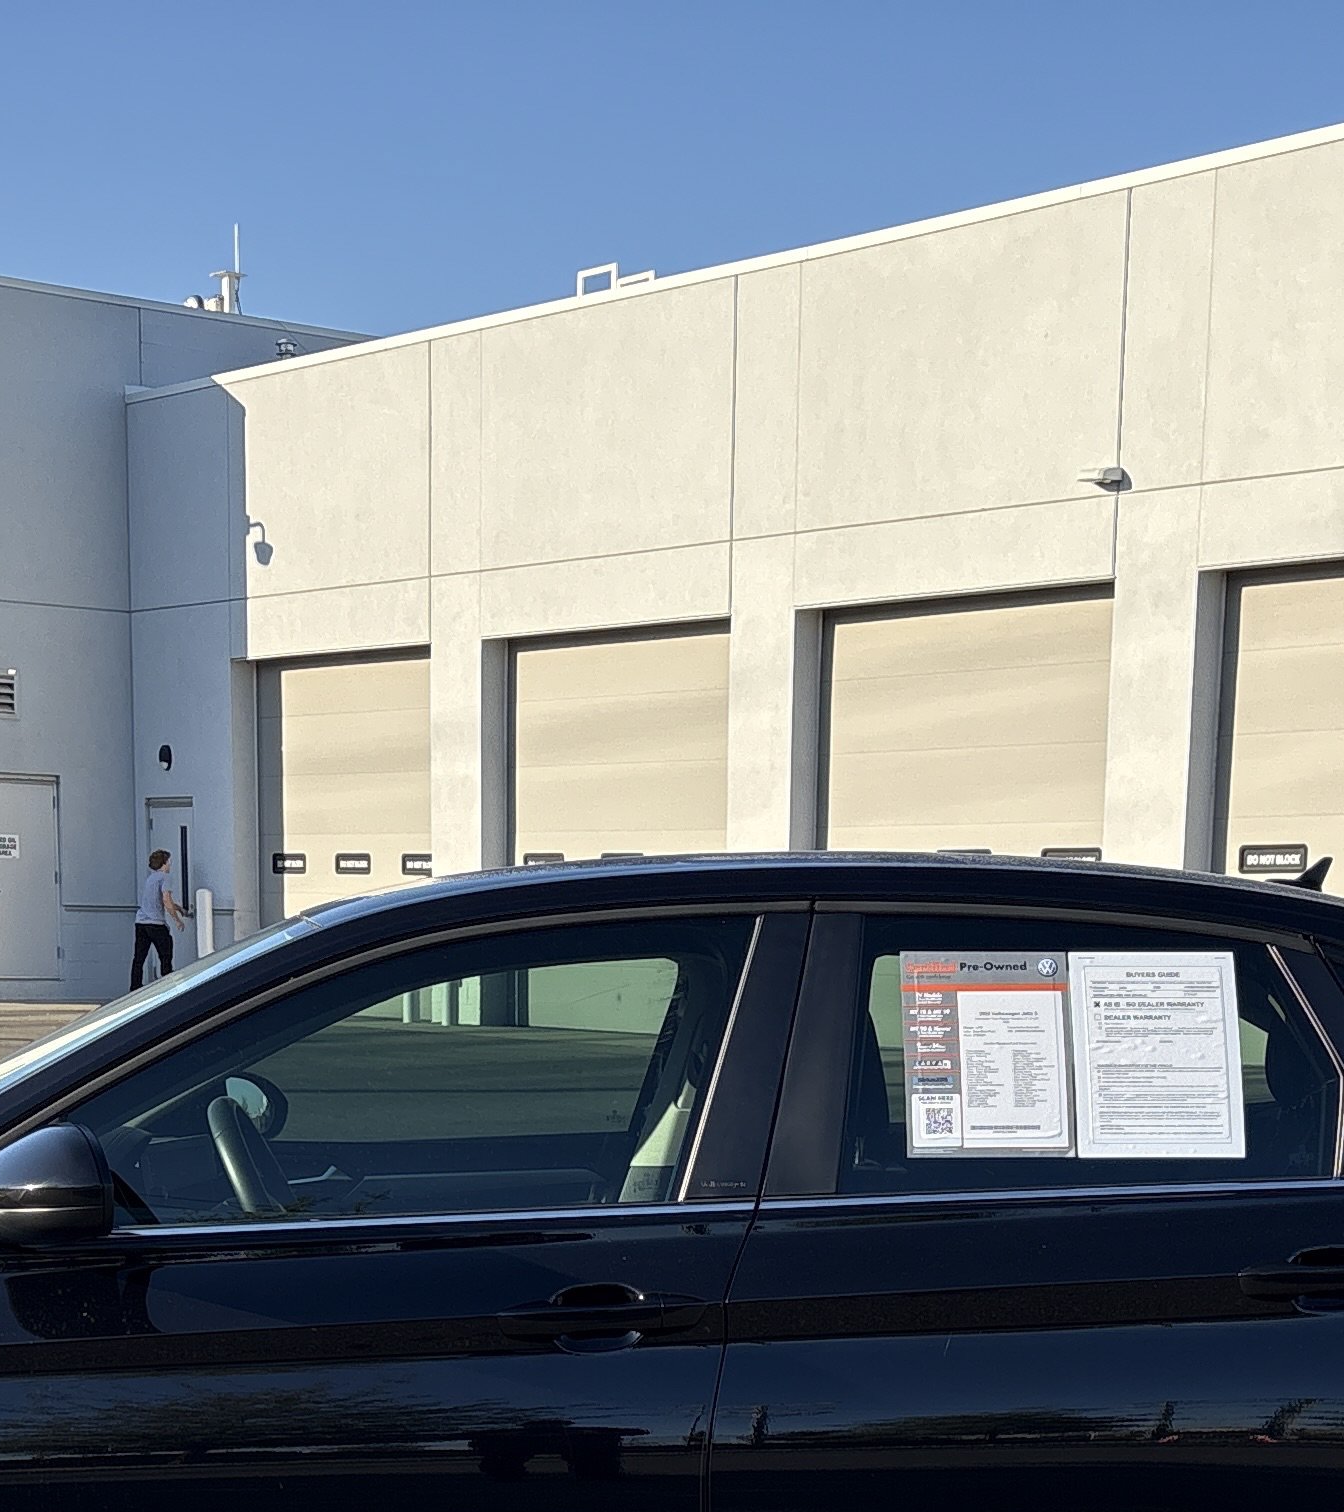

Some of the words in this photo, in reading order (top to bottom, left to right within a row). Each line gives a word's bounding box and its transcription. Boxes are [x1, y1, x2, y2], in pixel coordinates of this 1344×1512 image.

[1259, 854, 1275, 865] NOT
[1275, 853, 1301, 865] BLOCK
[959, 961, 1027, 972] Pre-Owned
